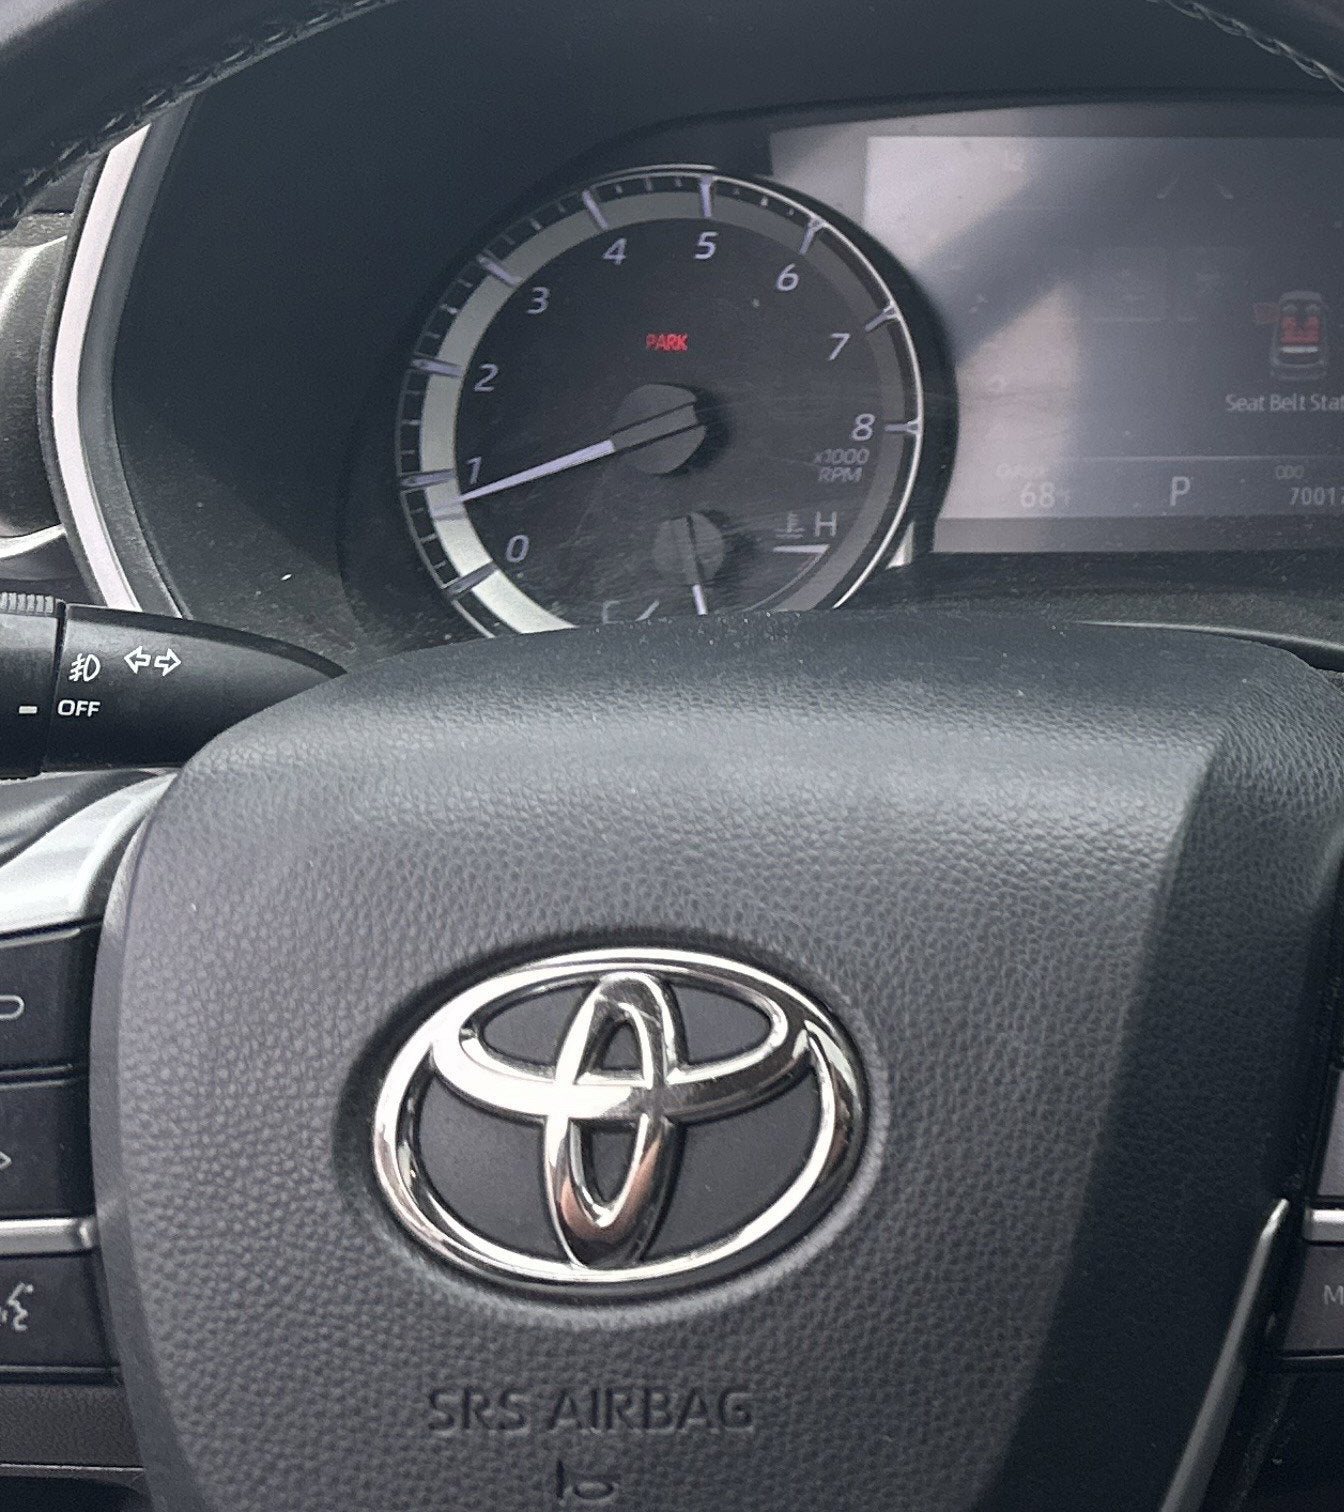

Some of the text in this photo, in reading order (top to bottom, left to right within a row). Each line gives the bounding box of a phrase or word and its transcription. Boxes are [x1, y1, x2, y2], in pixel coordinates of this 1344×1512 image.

[602, 237, 628, 265] 4
[694, 230, 719, 260] 5
[777, 263, 800, 292] 6
[526, 286, 551, 315] 3
[645, 331, 689, 352] PARK
[826, 333, 851, 361] 7
[474, 363, 499, 392] 2
[1225, 391, 1263, 413] Seat
[1269, 391, 1304, 414] Belt
[849, 413, 876, 442] 8
[467, 455, 485, 483] 1
[818, 466, 863, 482] RPM
[1168, 475, 1192, 507] P
[814, 510, 838, 537] H
[505, 533, 531, 563] 0
[56, 698, 101, 718] OFF
[425, 1386, 758, 1436] SRS AIRBAG
